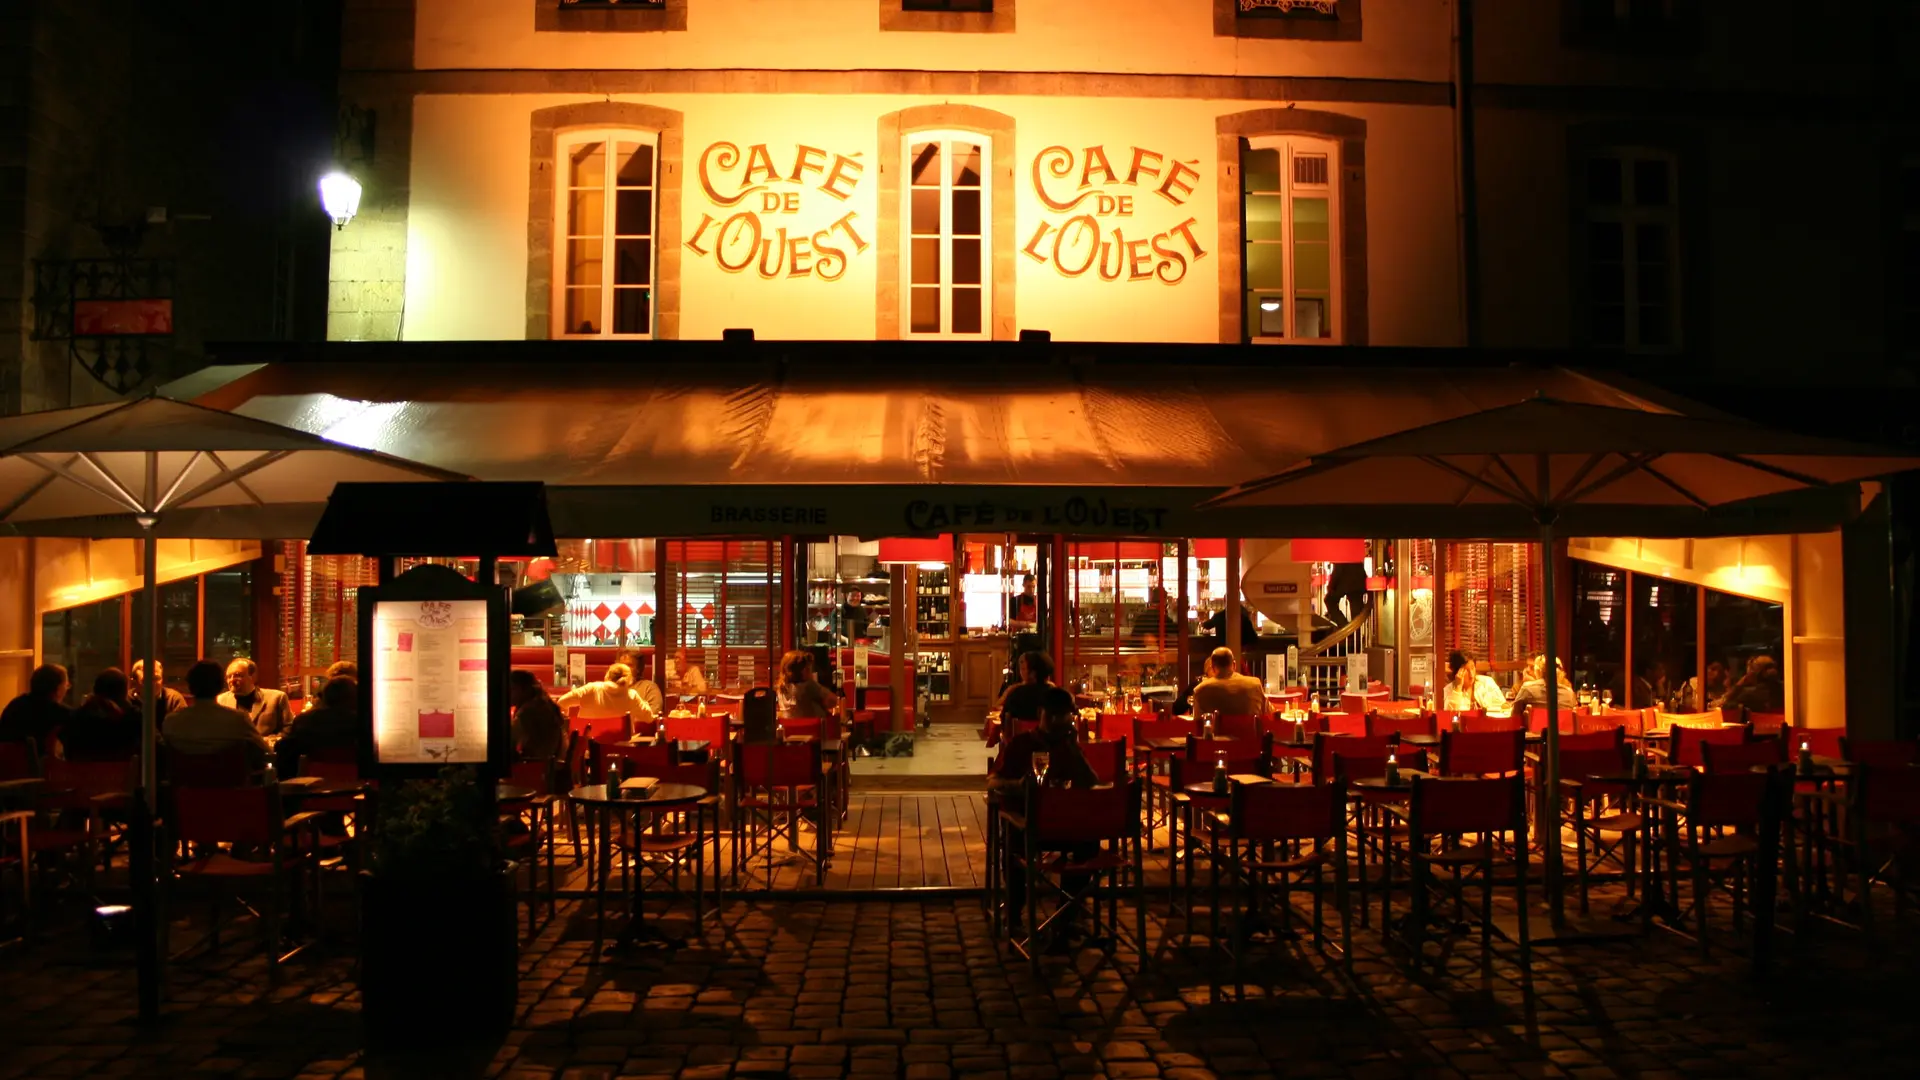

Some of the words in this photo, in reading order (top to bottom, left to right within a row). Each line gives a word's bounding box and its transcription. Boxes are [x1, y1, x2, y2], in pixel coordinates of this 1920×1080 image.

[697, 140, 864, 207] CAFÉ
[1030, 145, 1201, 211] CAFÉ
[761, 192, 799, 213] DE
[1096, 195, 1133, 216] DE
[683, 210, 870, 283] L'OUEST
[1021, 213, 1208, 285] L'OUEST
[711, 506, 827, 524] BRASSERIE
[905, 500, 994, 531] CAFÉ
[1005, 508, 1031, 522] DE
[1042, 497, 1169, 532] L'OUEST
